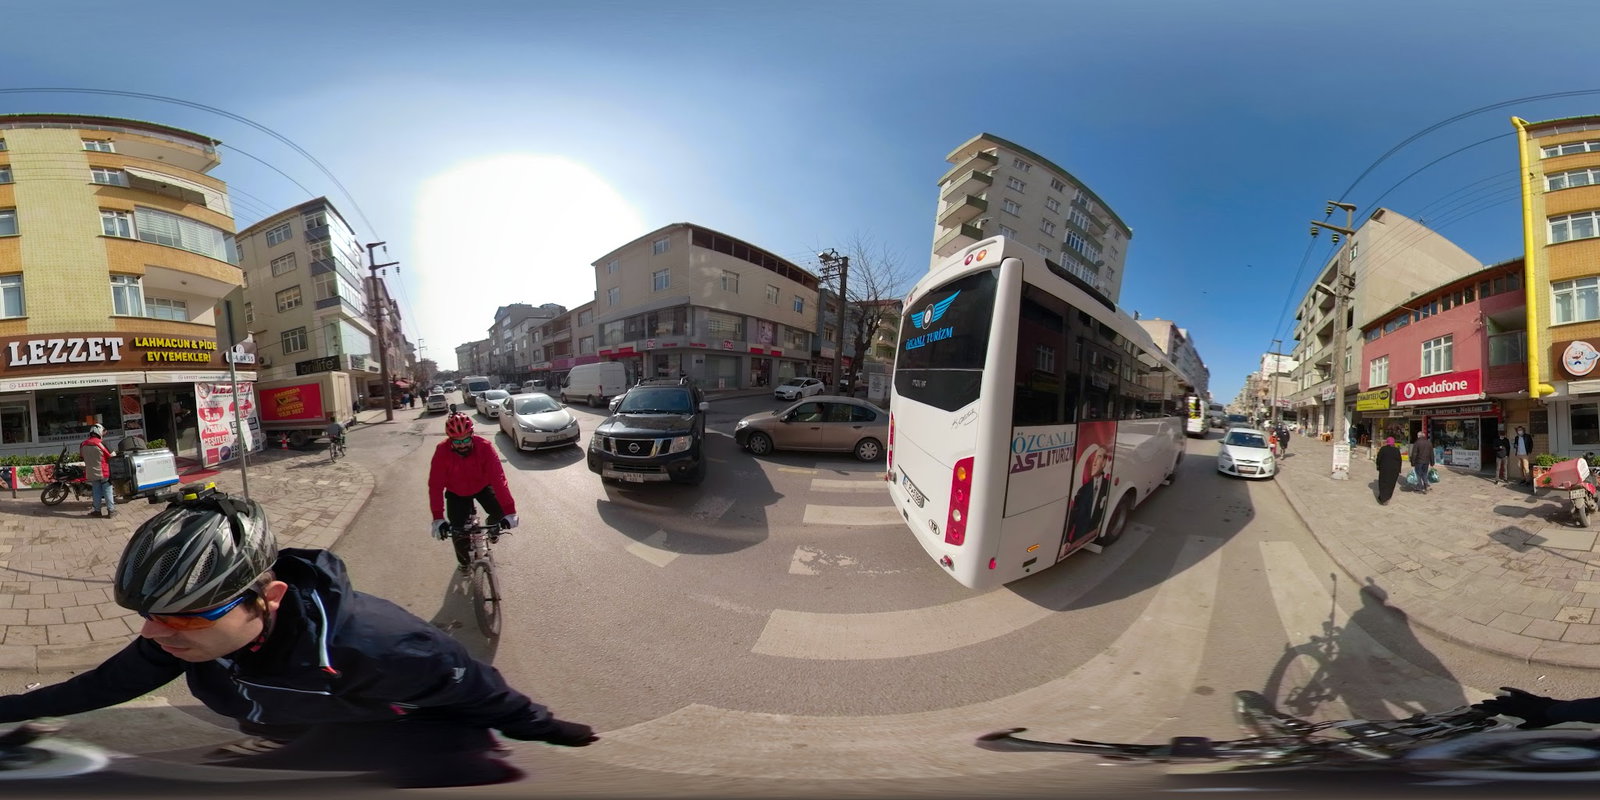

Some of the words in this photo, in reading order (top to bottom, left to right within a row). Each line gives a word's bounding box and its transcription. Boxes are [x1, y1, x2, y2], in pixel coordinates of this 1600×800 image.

[926, 326, 954, 343] TURİZM
[9, 337, 124, 367] LEZZET
[134, 337, 191, 350] LAHMACUN
[191, 340, 198, 349] &
[199, 337, 218, 350] PİDE
[159, 351, 212, 363] YEMEKLERİ
[1417, 380, 1468, 395] vodafone
[1012, 431, 1074, 454] ÖZCANLI
[1010, 450, 1051, 474] ASLI
